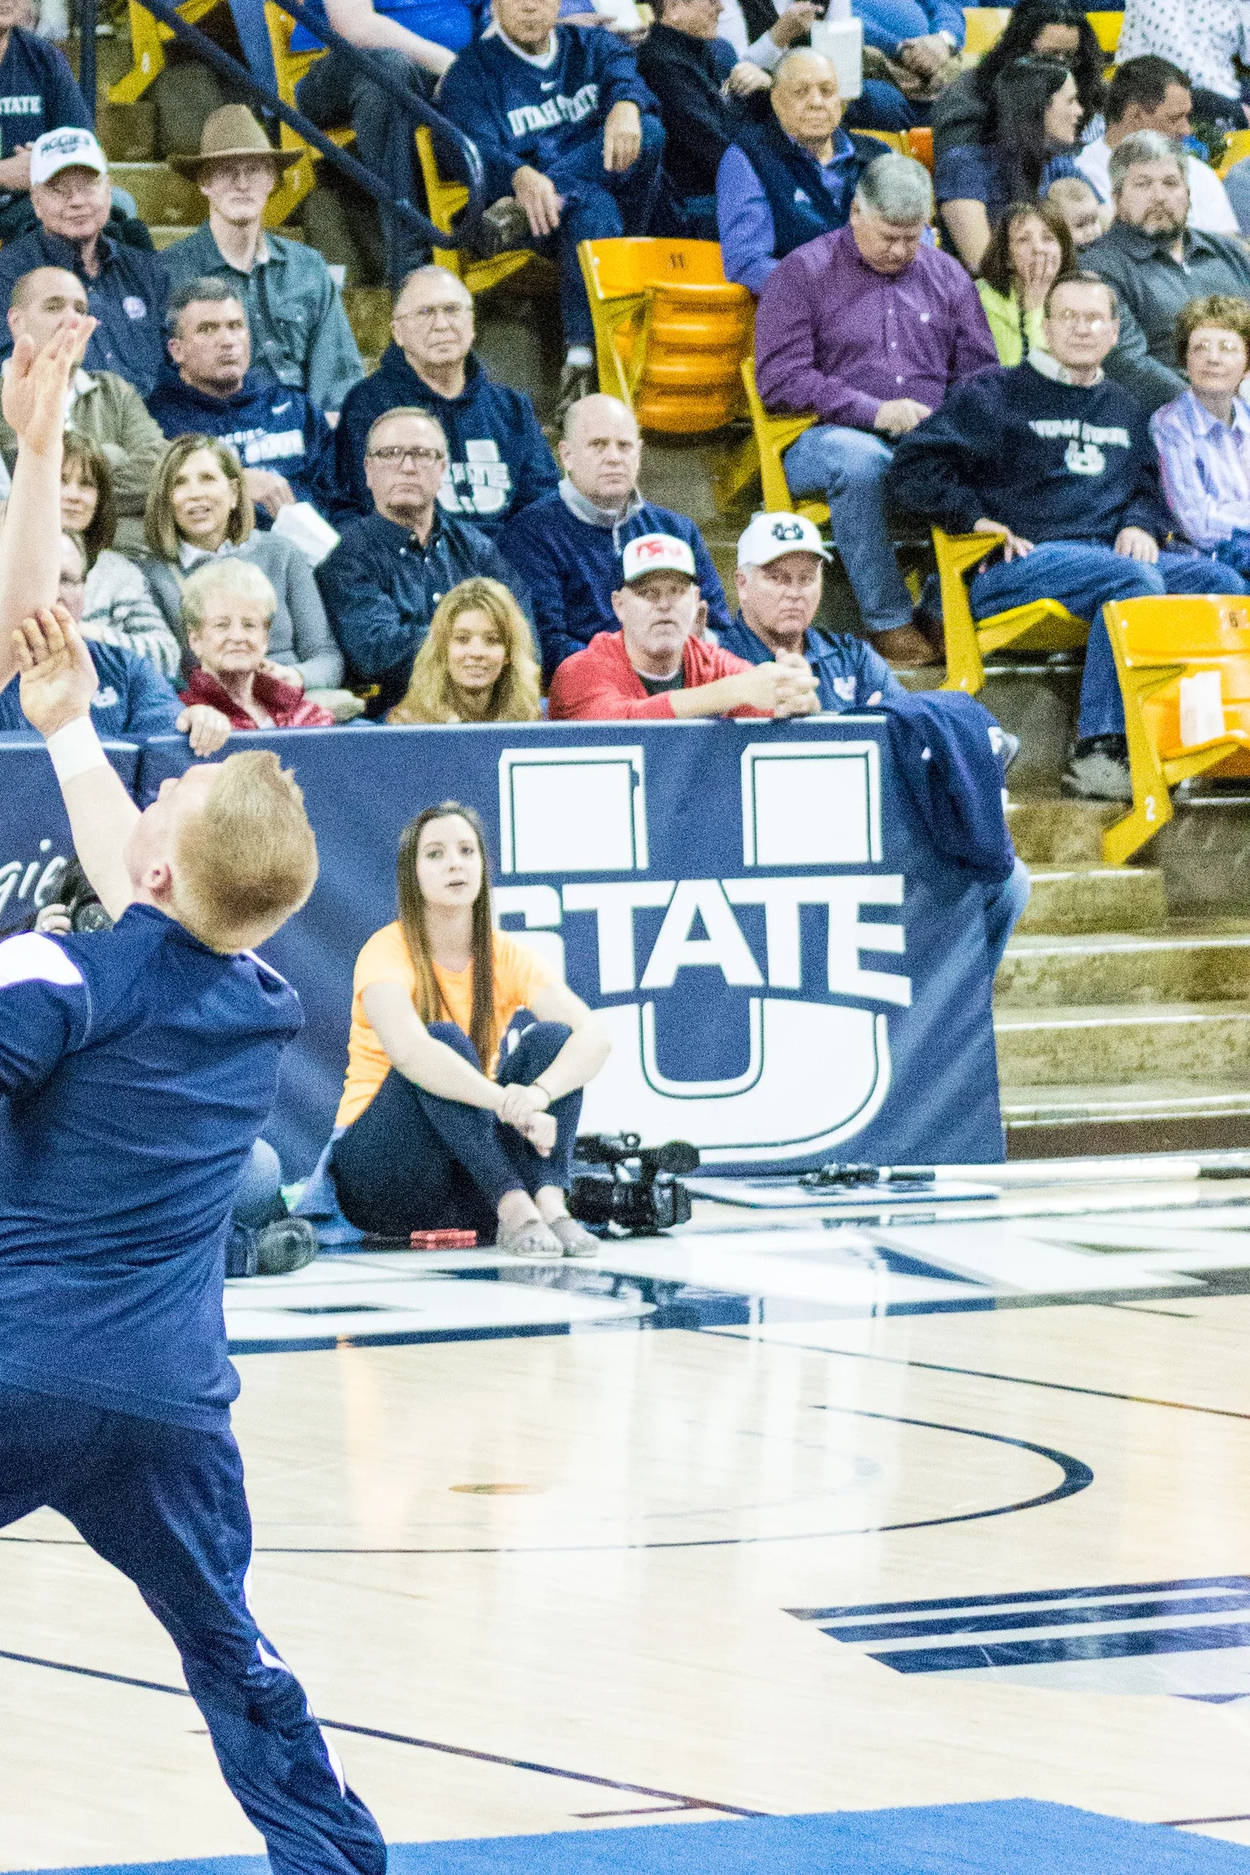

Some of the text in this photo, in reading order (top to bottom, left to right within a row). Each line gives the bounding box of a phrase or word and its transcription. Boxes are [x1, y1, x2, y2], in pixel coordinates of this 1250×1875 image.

[508, 97, 562, 138] UTAH
[1144, 795, 1157, 823] 2
[492, 873, 913, 1009] STATE
